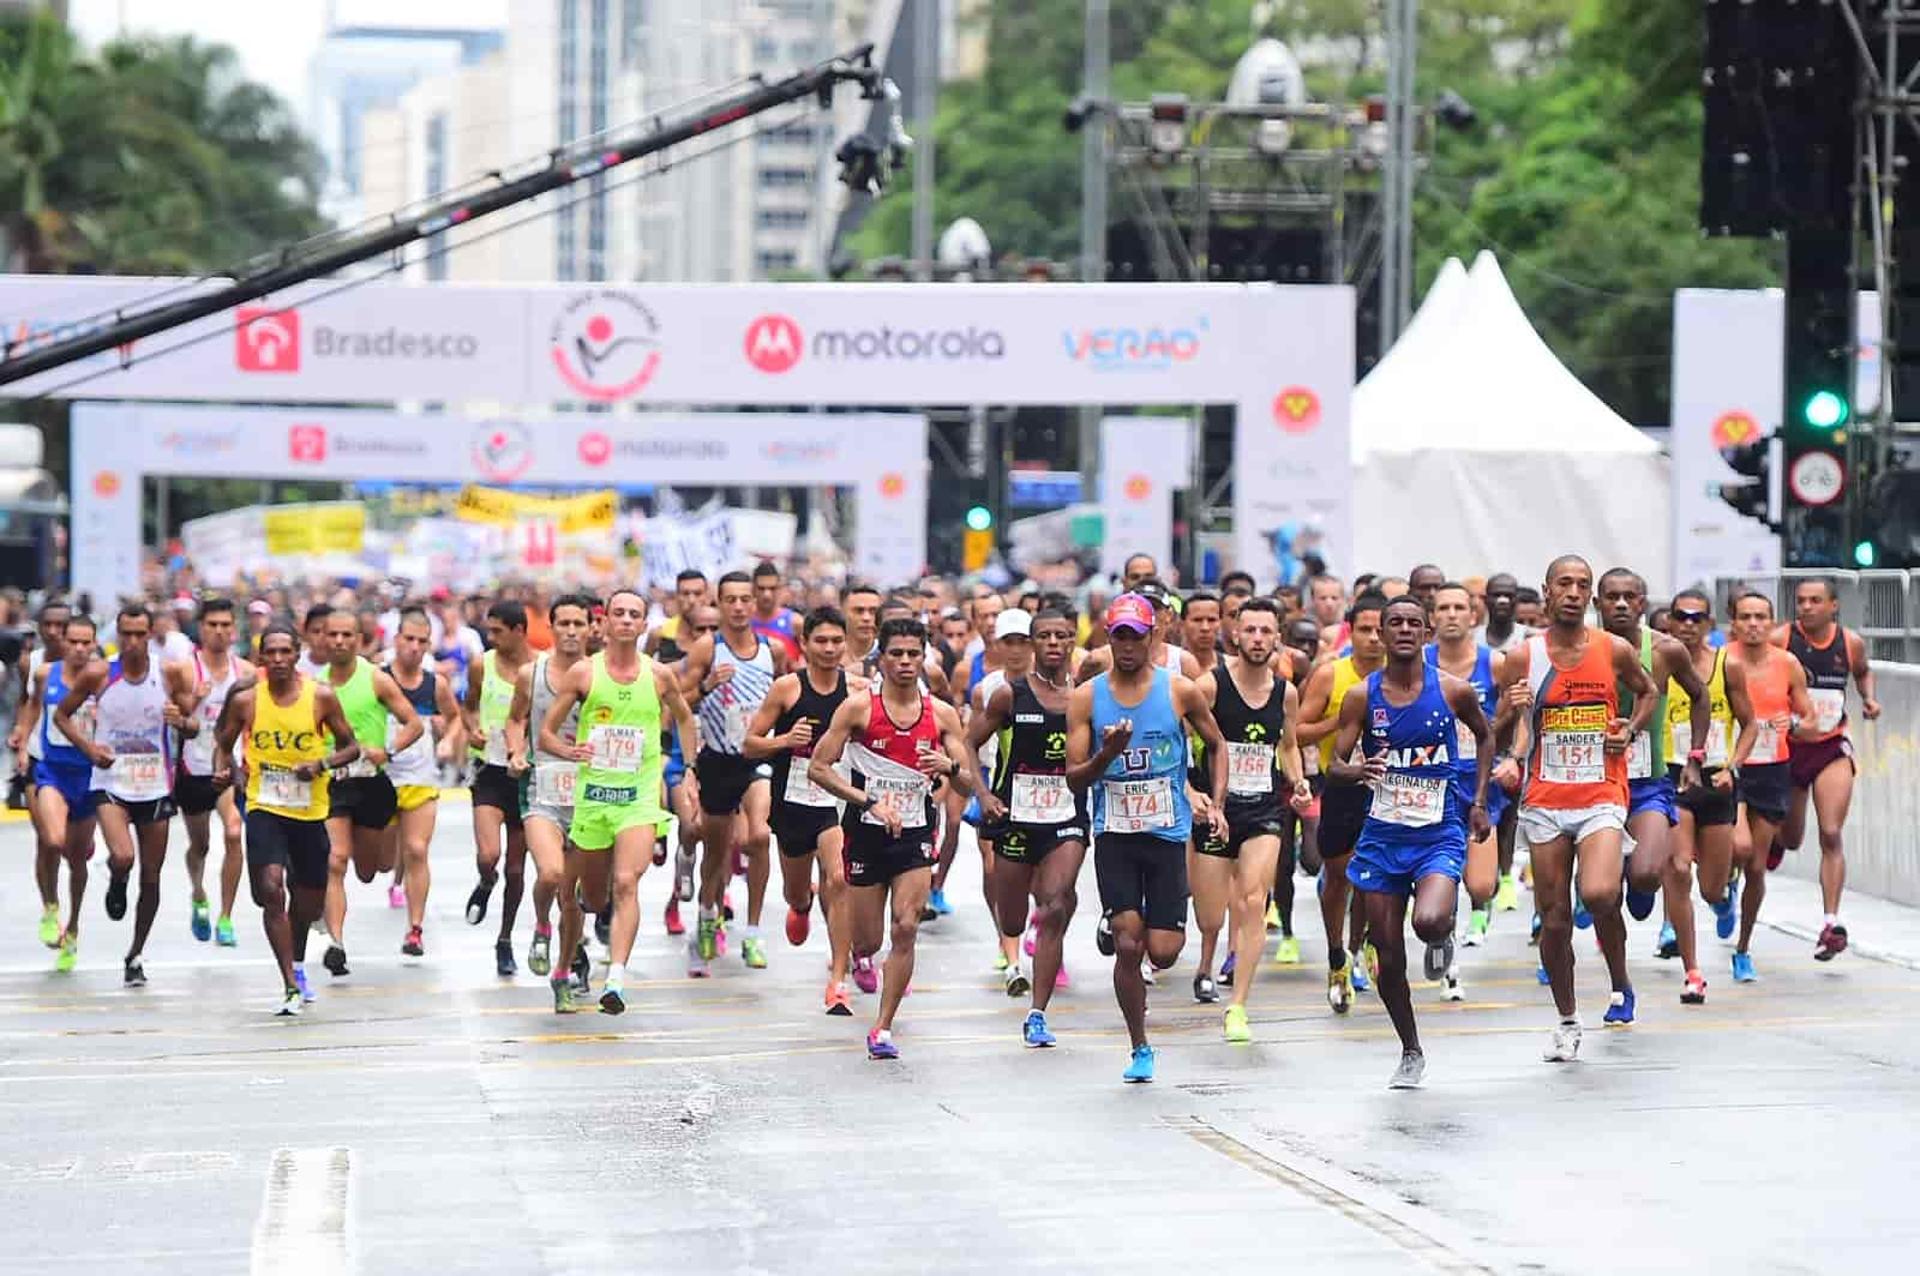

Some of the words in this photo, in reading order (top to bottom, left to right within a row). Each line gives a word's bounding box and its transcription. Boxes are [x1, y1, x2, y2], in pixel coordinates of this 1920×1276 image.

[313, 327, 479, 358] Bradesco
[812, 324, 1006, 359] motorola
[253, 729, 314, 752] CVC
[605, 738, 635, 757] 179
[1556, 734, 1596, 745] SANDER
[1384, 743, 1449, 769] AIXA
[1558, 746, 1593, 766] 151
[1030, 786, 1062, 808] 147
[1125, 783, 1149, 795] ERIC
[1120, 795, 1158, 817] 174
